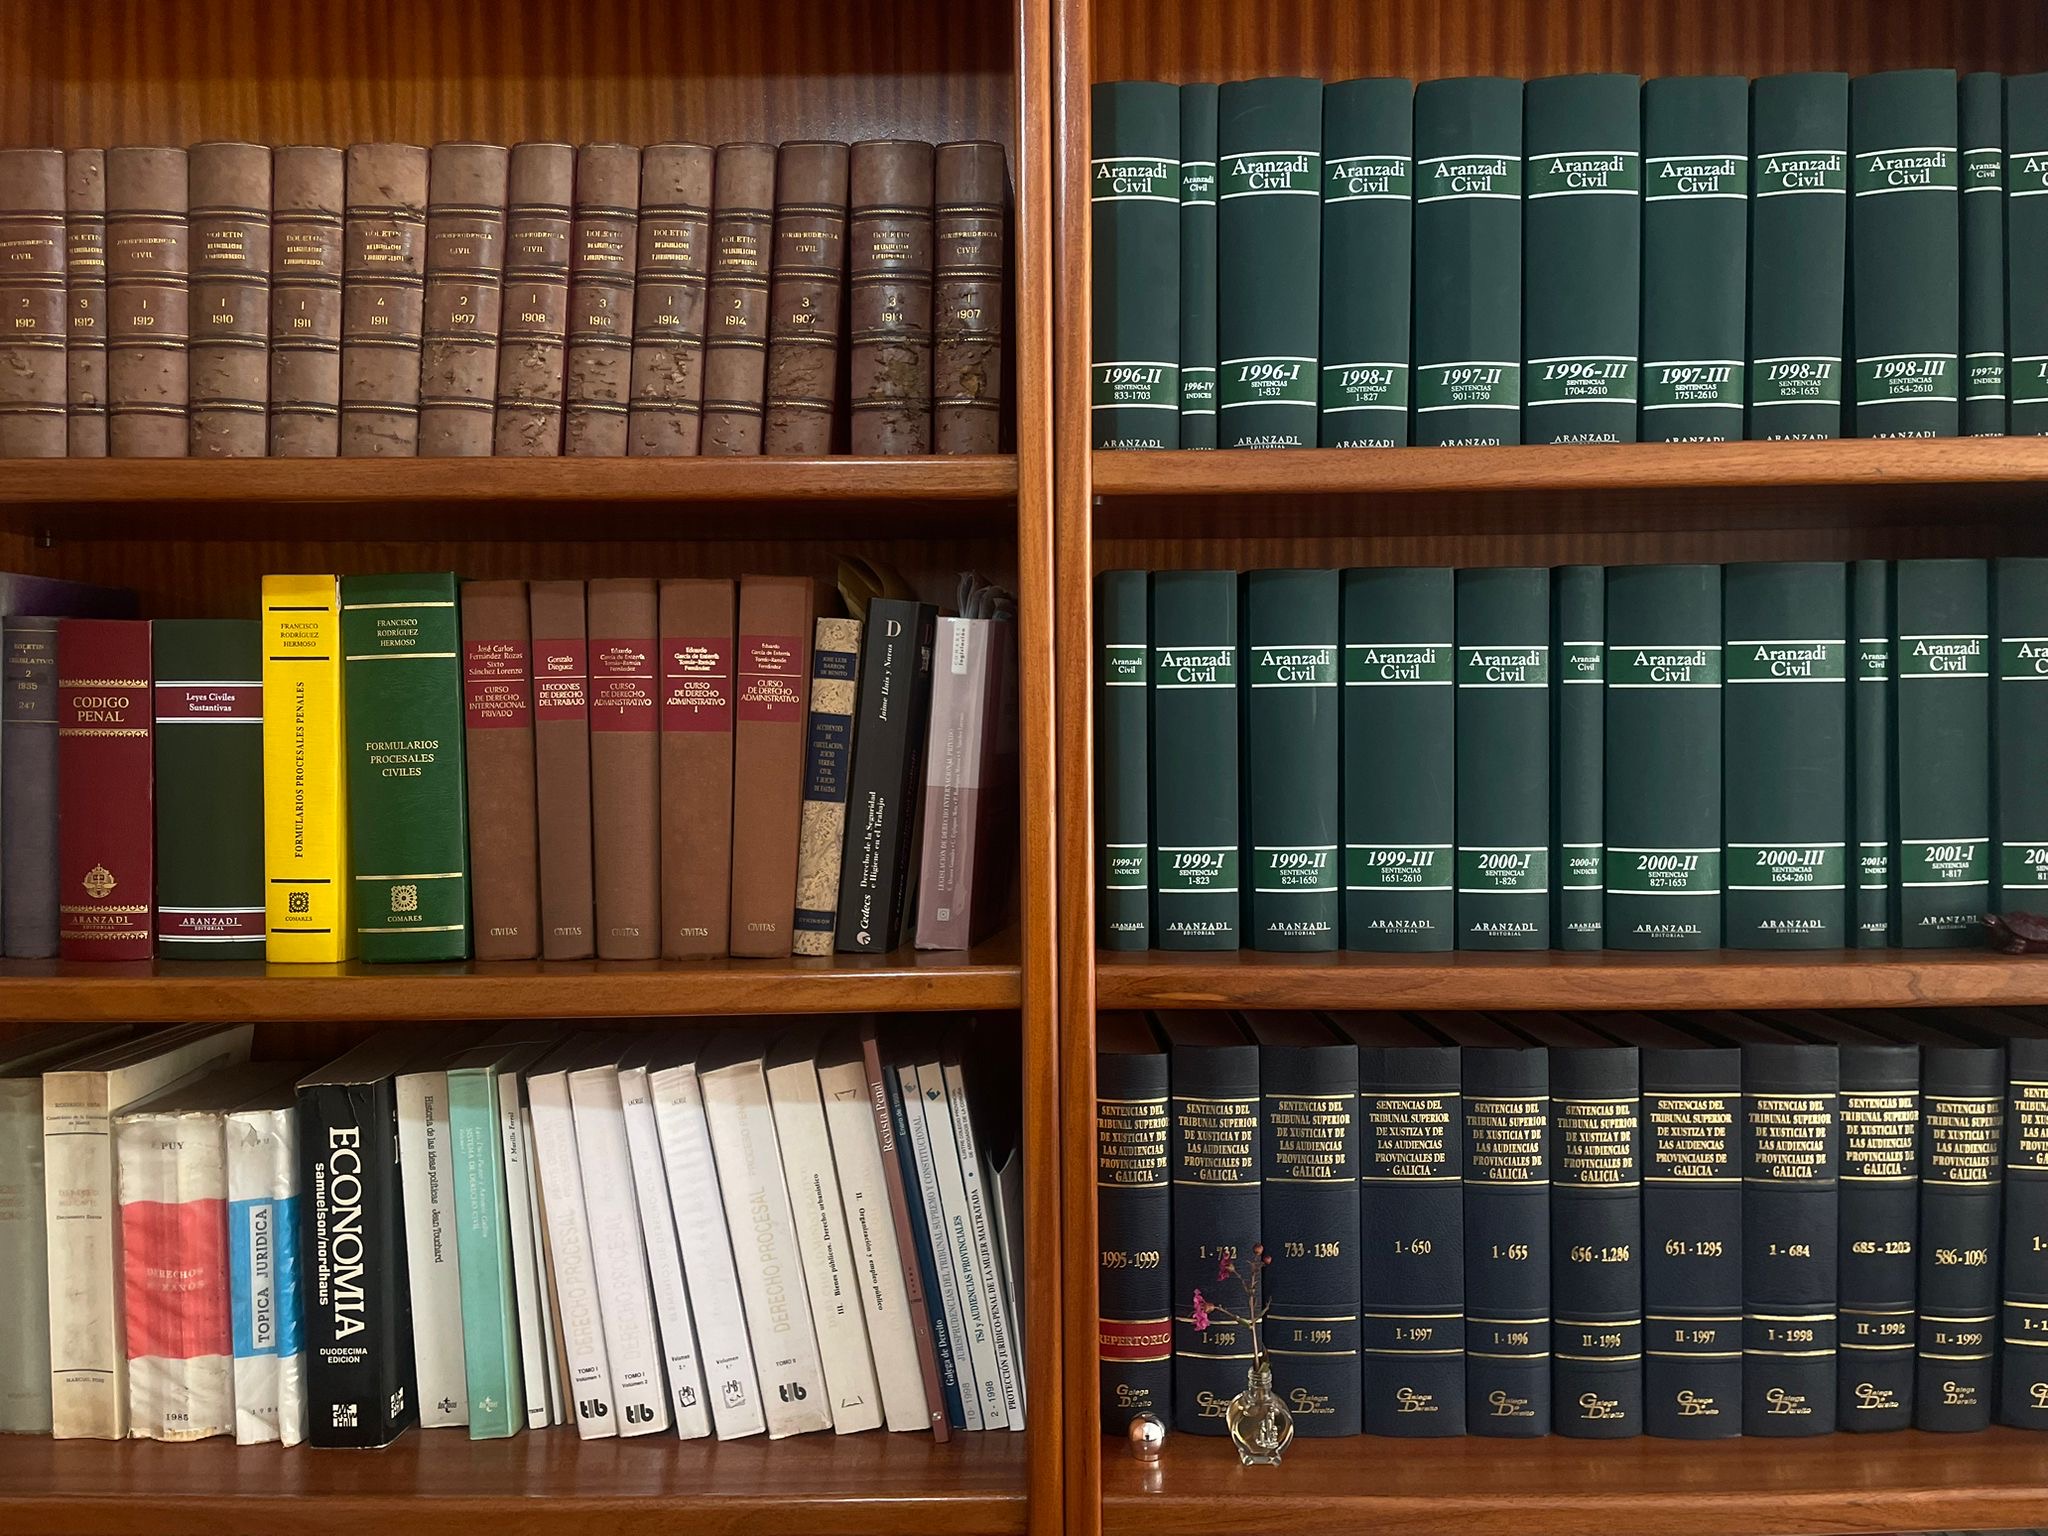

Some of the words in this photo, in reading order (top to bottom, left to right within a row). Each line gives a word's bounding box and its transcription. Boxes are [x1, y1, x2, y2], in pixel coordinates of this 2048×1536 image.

[1097, 162, 1167, 179] Aranzadi
[1232, 156, 1309, 177] Aranzadi
[1434, 160, 1507, 178] Aranzadi
[1549, 156, 1624, 174] Aranzadi
[1660, 160, 1735, 178] Aranzadi
[1765, 155, 1840, 174] Aranzadi
[1113, 177, 1152, 193] Civil
[1249, 170, 1293, 189] Civil
[1451, 175, 1491, 192] Civil
[1567, 171, 1607, 187] Civil
[1677, 176, 1719, 192] Civil
[1782, 171, 1824, 187] Civil
[1189, 184, 1207, 192] Civil
[16, 319, 35, 327] 1912
[75, 318, 94, 326] 1912
[134, 316, 154, 325] 1912
[213, 314, 233, 323] 1910
[294, 318, 311, 327] 1911
[371, 316, 388, 325] 1911
[452, 313, 475, 324] 1907
[522, 313, 545, 322] 1908
[659, 315, 680, 325] 1914
[726, 315, 747, 325] 1914
[1103, 368, 1162, 383] 1996-II
[1238, 364, 1301, 382] 1996-I
[1441, 368, 1502, 385] 1997-II
[1543, 363, 1628, 380] 1996-III
[1660, 367, 1731, 384] 1997-III
[1768, 363, 1831, 380] 1998-II
[1873, 360, 1946, 379] 1998-III
[1340, 369, 1393, 386] 1998-I
[1114, 391, 1151, 400] 833-1703
[1453, 392, 1490, 401] 901-1750
[1675, 391, 1718, 399] 1751-2610
[1781, 387, 1819, 395] 828-1653
[377, 628, 419, 637] RODRÍGUEZ
[886, 620, 901, 637] D
[1161, 651, 1231, 667] Aranzadi
[1633, 650, 1707, 666] Aranzadi
[1177, 666, 1216, 682] Civil
[1651, 666, 1691, 682] Civil
[73, 697, 129, 708] CODIGO
[186, 693, 207, 702] Leyes
[209, 693, 235, 701] Civiles
[296, 682, 304, 723] PENALES
[553, 698, 585, 706] TRABAJO
[667, 698, 726, 706] ADMINISTRATIVO
[189, 703, 232, 711] Sustantivas
[469, 701, 526, 710] INTERNACIONAL
[78, 711, 124, 722] PENAL
[366, 740, 439, 751] FORMULARIOS
[296, 726, 304, 786] PROCESALES
[371, 753, 434, 764] PROCESALES
[382, 767, 421, 777] CIVILES
[866, 791, 876, 831] Seguridad
[295, 789, 304, 858] FORMULARIOS
[864, 832, 872, 840] la
[869, 851, 879, 881] Higiene
[874, 797, 885, 829] Trabajo
[864, 841, 871, 852] de
[1173, 853, 1225, 869] 1999-I
[1270, 852, 1328, 868] 1999-II
[1367, 851, 1434, 866] 1999-III
[1478, 854, 1531, 869] 2000-I
[1637, 855, 1699, 870] 2000-II
[1756, 850, 1825, 865] 2000-III
[860, 853, 870, 887] Derecho
[1189, 876, 1210, 885] 1-823
[1282, 876, 1317, 884] 824-1650
[1382, 874, 1422, 882] 1651-2610
[1650, 878, 1687, 887] 827-1653
[860, 894, 871, 929] Cedecs
[71, 914, 129, 925] ARANZADI
[181, 917, 239, 926] ARANZADI
[1168, 922, 1229, 931] ARANZADI
[1370, 920, 1431, 928] ARANZADI
[490, 927, 517, 936] CIVITAS
[681, 928, 708, 936] CIVITAS
[1636, 924, 1698, 933] ARANZADI
[871, 1081, 885, 1111] Penal
[425, 1096, 434, 1127] Historia
[1376, 1100, 1425, 1110] SENTENCIAS
[1427, 1100, 1442, 1109] DEL
[1369, 1113, 1409, 1123] TRIBUNAL
[1411, 1113, 1449, 1123] SUPERIOR
[880, 1113, 893, 1152] Revista
[1376, 1127, 1388, 1136] DE
[1389, 1127, 1424, 1136] XUSTIZA
[1425, 1127, 1431, 1136] Y
[1432, 1126, 1443, 1136] DE
[161, 1141, 185, 1151] PUY
[1378, 1140, 1393, 1149] LAS
[1394, 1140, 1442, 1149] AUDIENCIAS
[427, 1152, 437, 1171] ideas
[1376, 1153, 1432, 1163] PROVINCIALES
[1434, 1153, 1445, 1162] DE
[1200, 1169, 1238, 1181] GALICIA
[1393, 1165, 1431, 1175] GALICIA
[814, 1173, 824, 1211] urbanístico
[971, 1189, 986, 1241] MALTRATADA
[315, 1163, 330, 1305] samuelson/nordhaus
[326, 1126, 365, 1340] ECONOMIA
[821, 1212, 831, 1241] Derecho
[255, 1209, 268, 1278] JURIDICA
[434, 1230, 443, 1263] Touchard
[953, 1215, 971, 1273] PROVINCIALES
[980, 1242, 990, 1269] MUJER
[985, 1270, 994, 1281] LA
[987, 1282, 996, 1293] DE
[964, 1274, 981, 1321] AUDIENCIAS
[257, 1287, 270, 1343] TOPICA
[989, 1294, 1008, 1358] JURÍDICO-PENAL
[974, 1328, 985, 1344] TSJ
[985, 1380, 996, 1402] 1998
[1000, 1359, 1017, 1410] PROTECCIÓN
